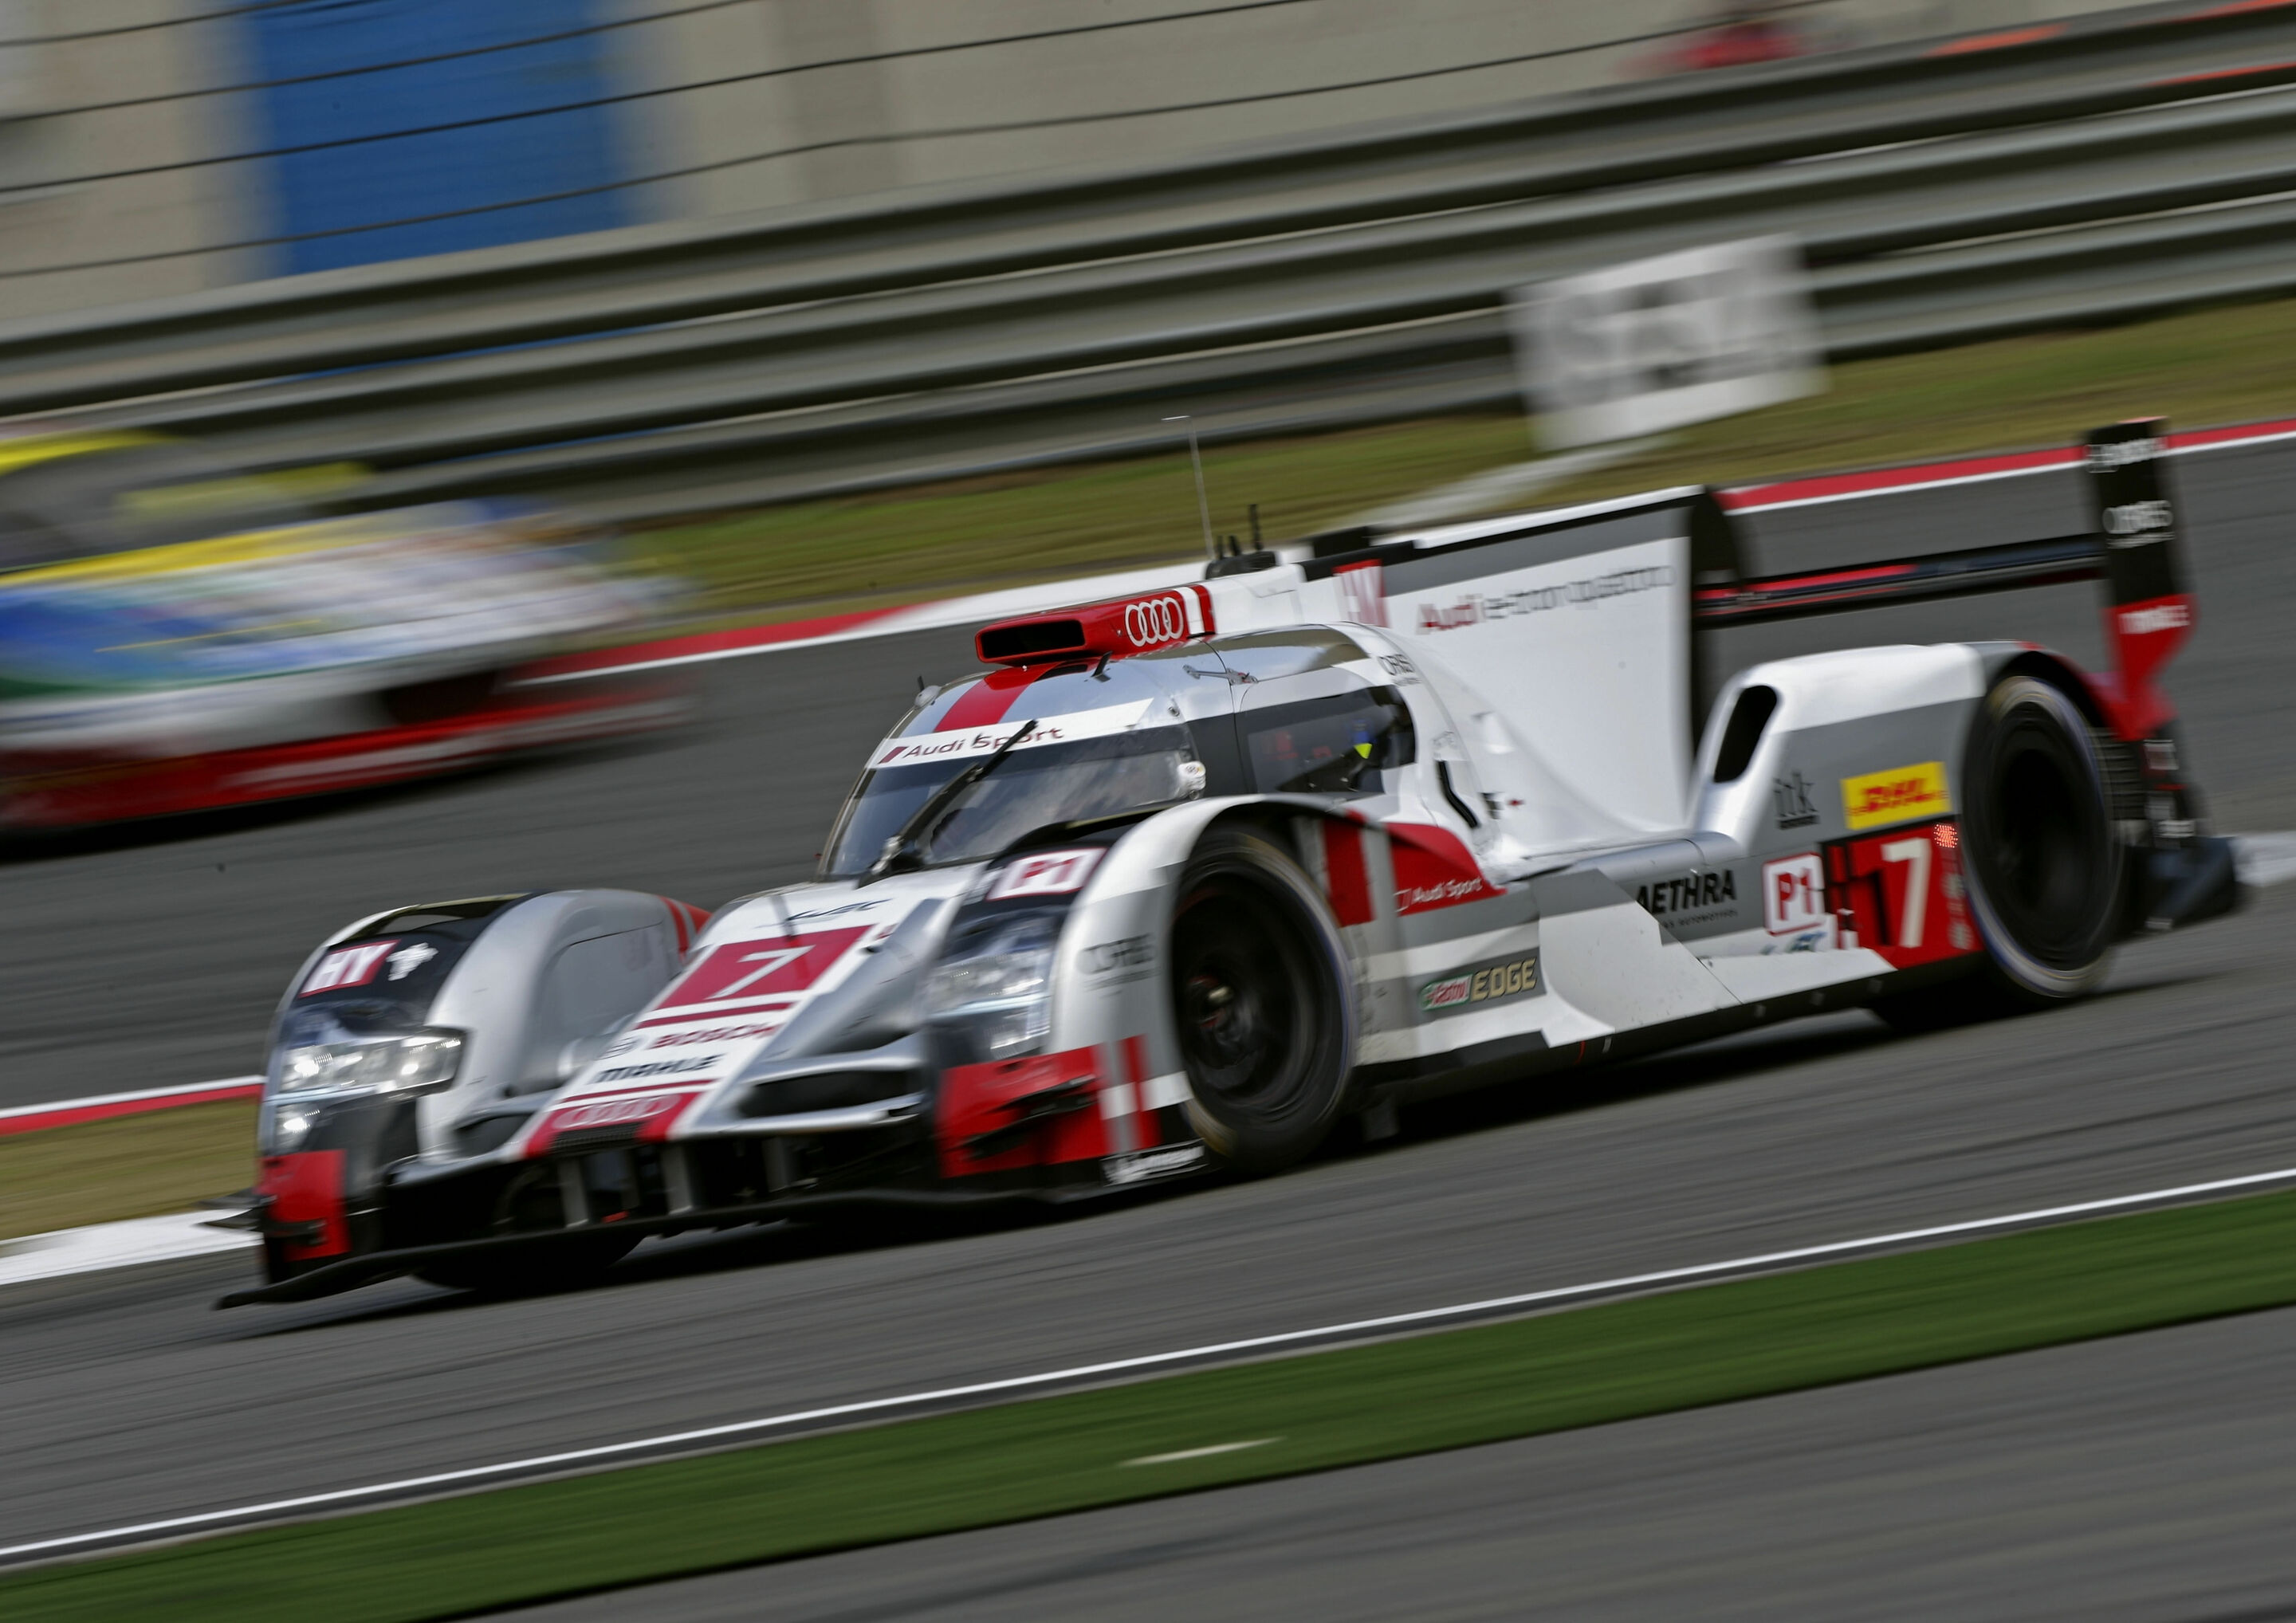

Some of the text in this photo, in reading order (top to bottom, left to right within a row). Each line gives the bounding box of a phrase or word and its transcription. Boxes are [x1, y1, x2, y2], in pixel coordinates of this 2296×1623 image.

[902, 739, 966, 758] Audi
[1008, 855, 1084, 891] P1
[1411, 883, 1445, 904] Audi
[1637, 869, 1737, 915] AETHRA
[1776, 867, 1814, 921] P1
[1881, 837, 1932, 949] 7
[300, 941, 397, 994] HY
[704, 945, 816, 1000] 7
[1470, 957, 1538, 1003] EDGE
[588, 1053, 729, 1085] MAHLE
